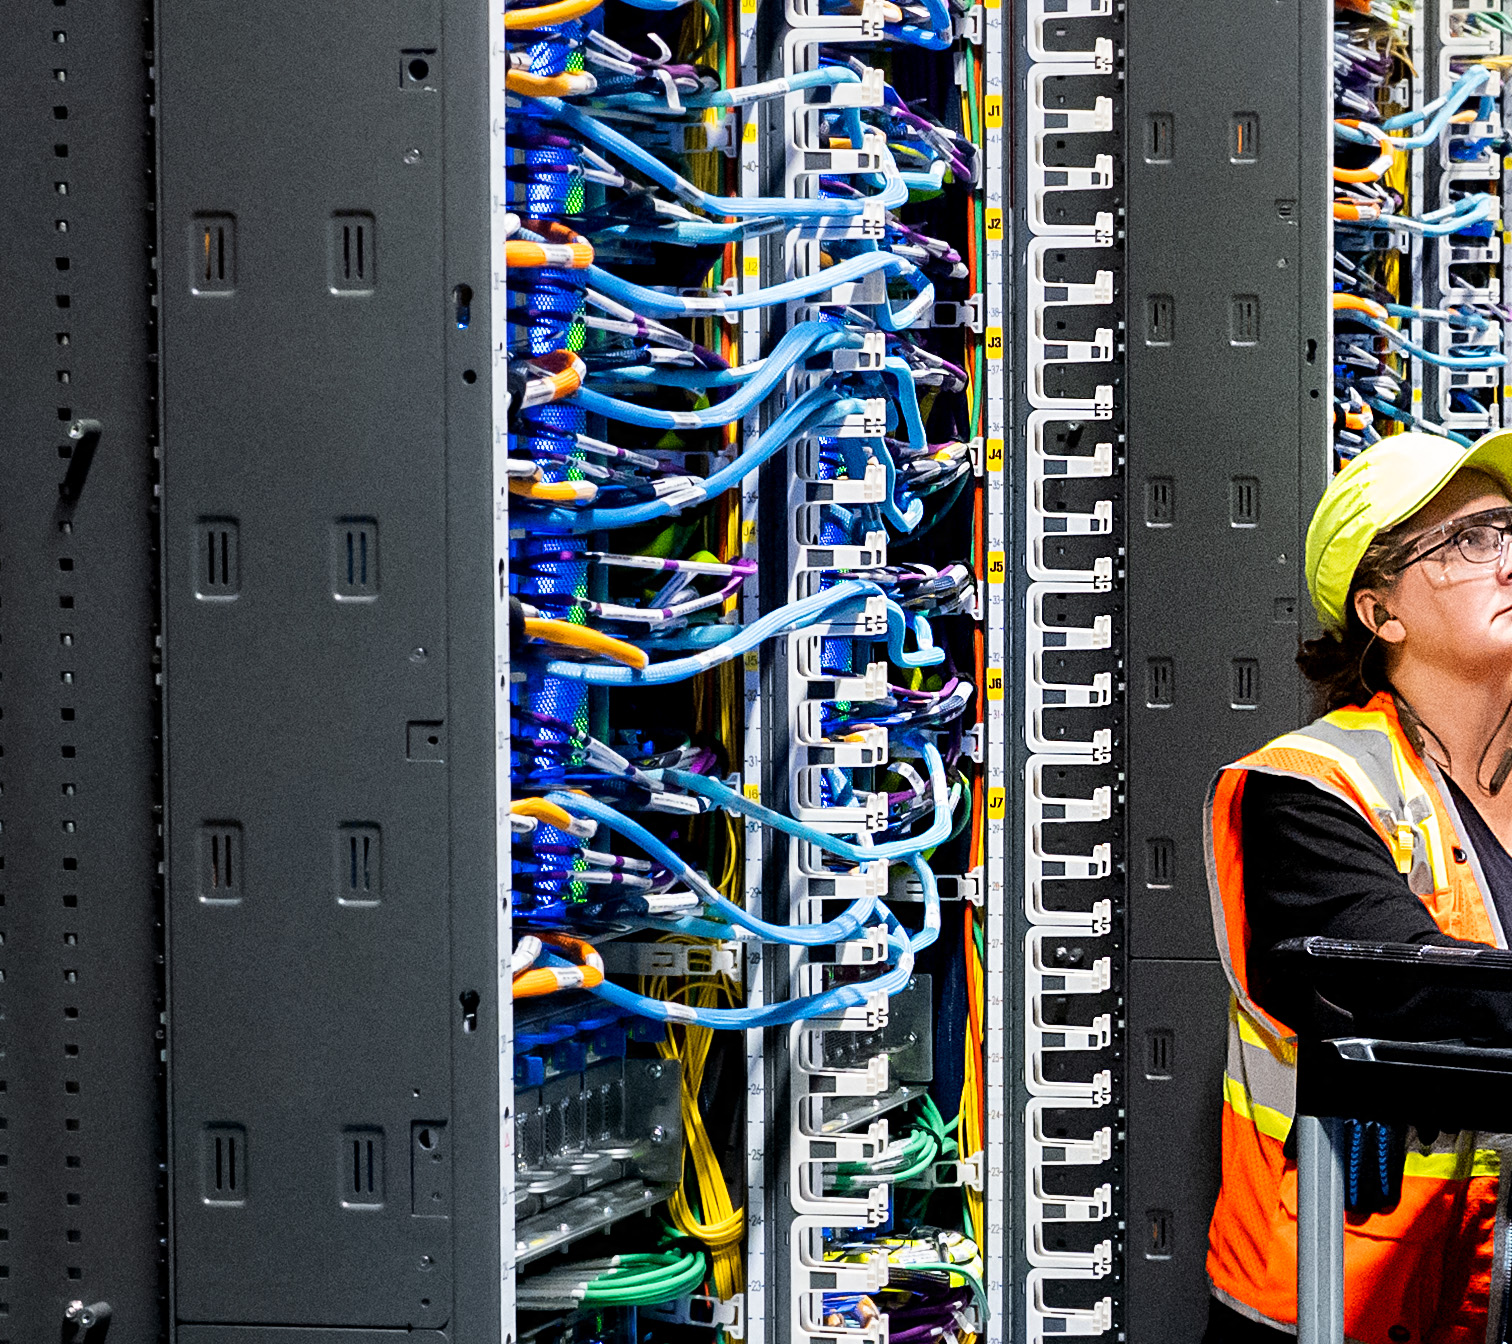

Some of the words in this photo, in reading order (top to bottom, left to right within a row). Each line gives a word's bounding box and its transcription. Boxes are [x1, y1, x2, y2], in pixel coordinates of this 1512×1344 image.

[988, 105, 1000, 117] J1
[988, 218, 1001, 230] J2
[745, 262, 758, 272] J2
[988, 336, 1002, 348] J3
[988, 448, 1002, 460] J4
[990, 561, 1004, 573] J5
[748, 756, 758, 768] 31
[990, 796, 1004, 809] J7
[750, 1083, 762, 1096] 26
[751, 1148, 762, 1161] 25
[751, 1214, 762, 1226] 24
[751, 1280, 761, 1292] 23
